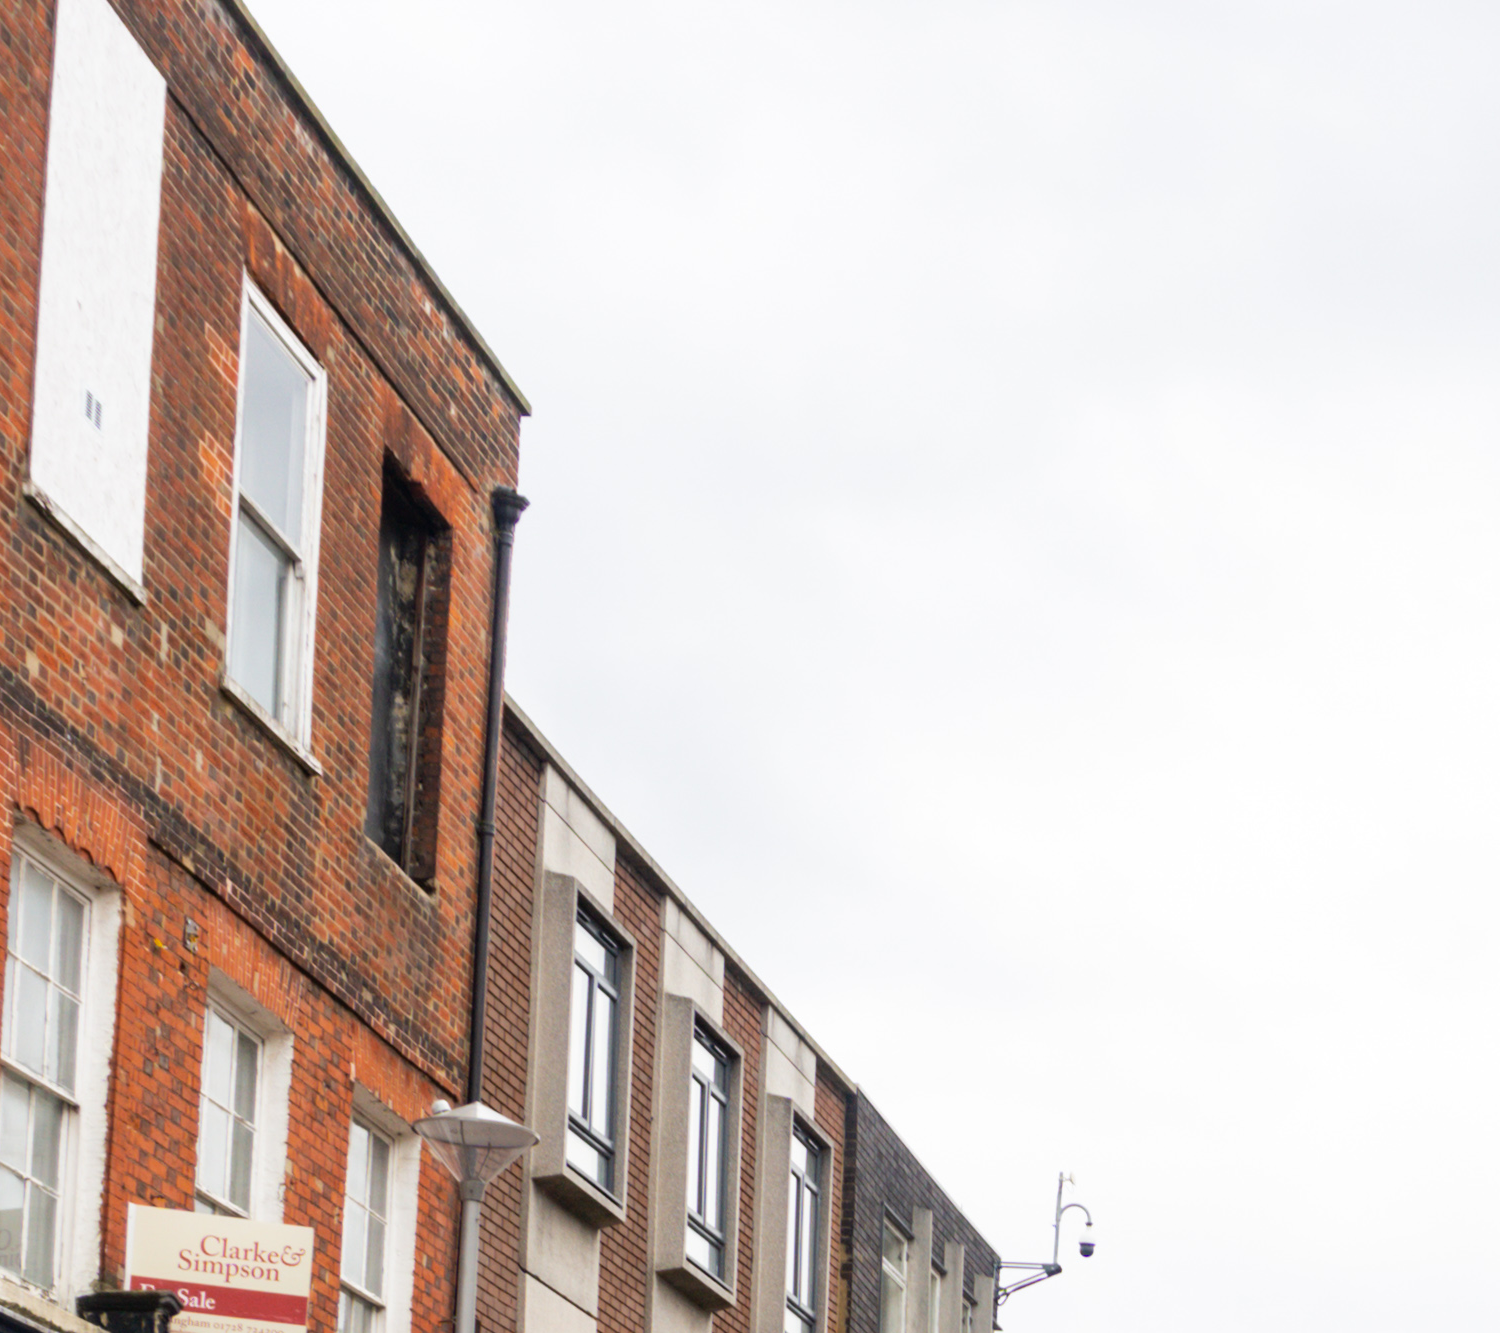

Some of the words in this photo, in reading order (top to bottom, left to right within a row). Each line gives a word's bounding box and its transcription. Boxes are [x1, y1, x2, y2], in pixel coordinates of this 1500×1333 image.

[178, 1249, 280, 1283] Simpson
[177, 1288, 216, 1310] Sale
[213, 1321, 243, 1333] 01728
